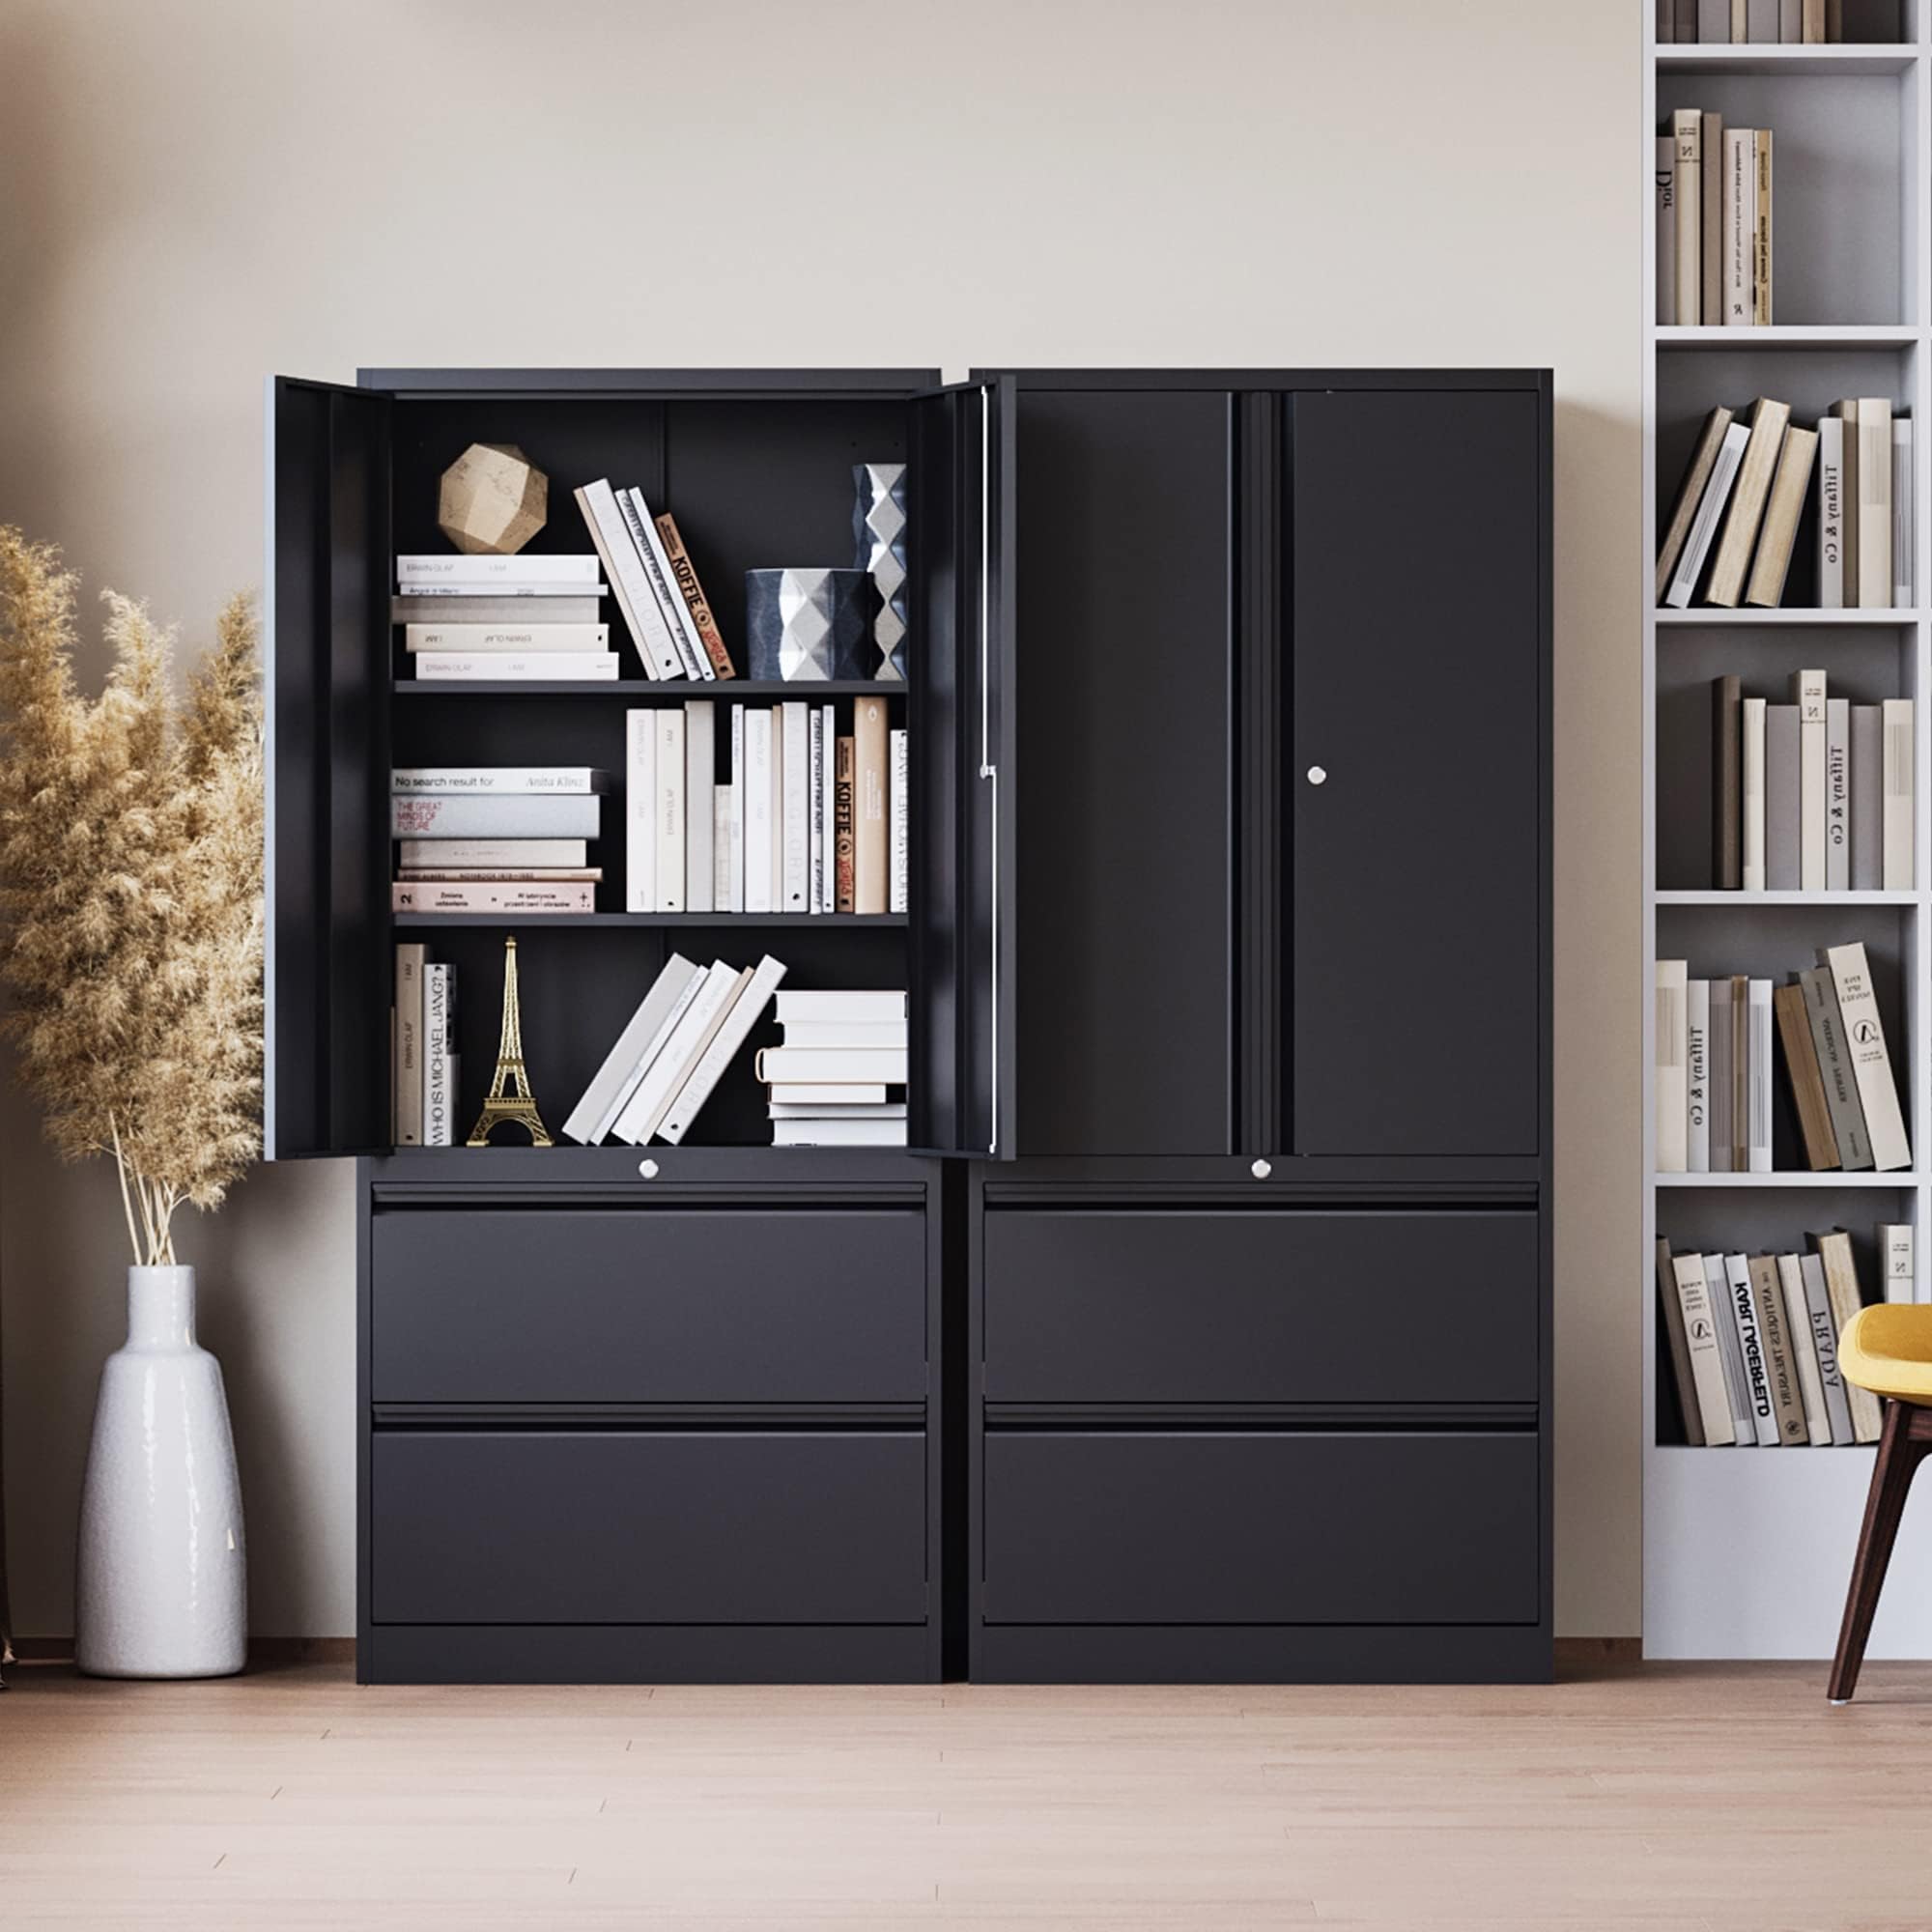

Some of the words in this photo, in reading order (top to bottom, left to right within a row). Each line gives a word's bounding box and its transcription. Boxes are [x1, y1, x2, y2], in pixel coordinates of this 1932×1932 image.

[672, 555, 704, 610] KOFFIE
[395, 777, 411, 787] No
[412, 777, 446, 787] search
[450, 777, 477, 786] result
[480, 777, 495, 786] for
[397, 802, 413, 811] THE
[414, 802, 442, 811] GREAT
[838, 781, 851, 836] KOFFIE
[397, 812, 424, 821] MINDS
[425, 811, 436, 821] OF
[397, 821, 430, 831] FUTURE
[400, 894, 412, 904] 2
[432, 977, 446, 1024] JANG?
[432, 1027, 445, 1089] MICHAEL
[432, 1091, 444, 1106] IS
[432, 1108, 445, 1146] WHO
